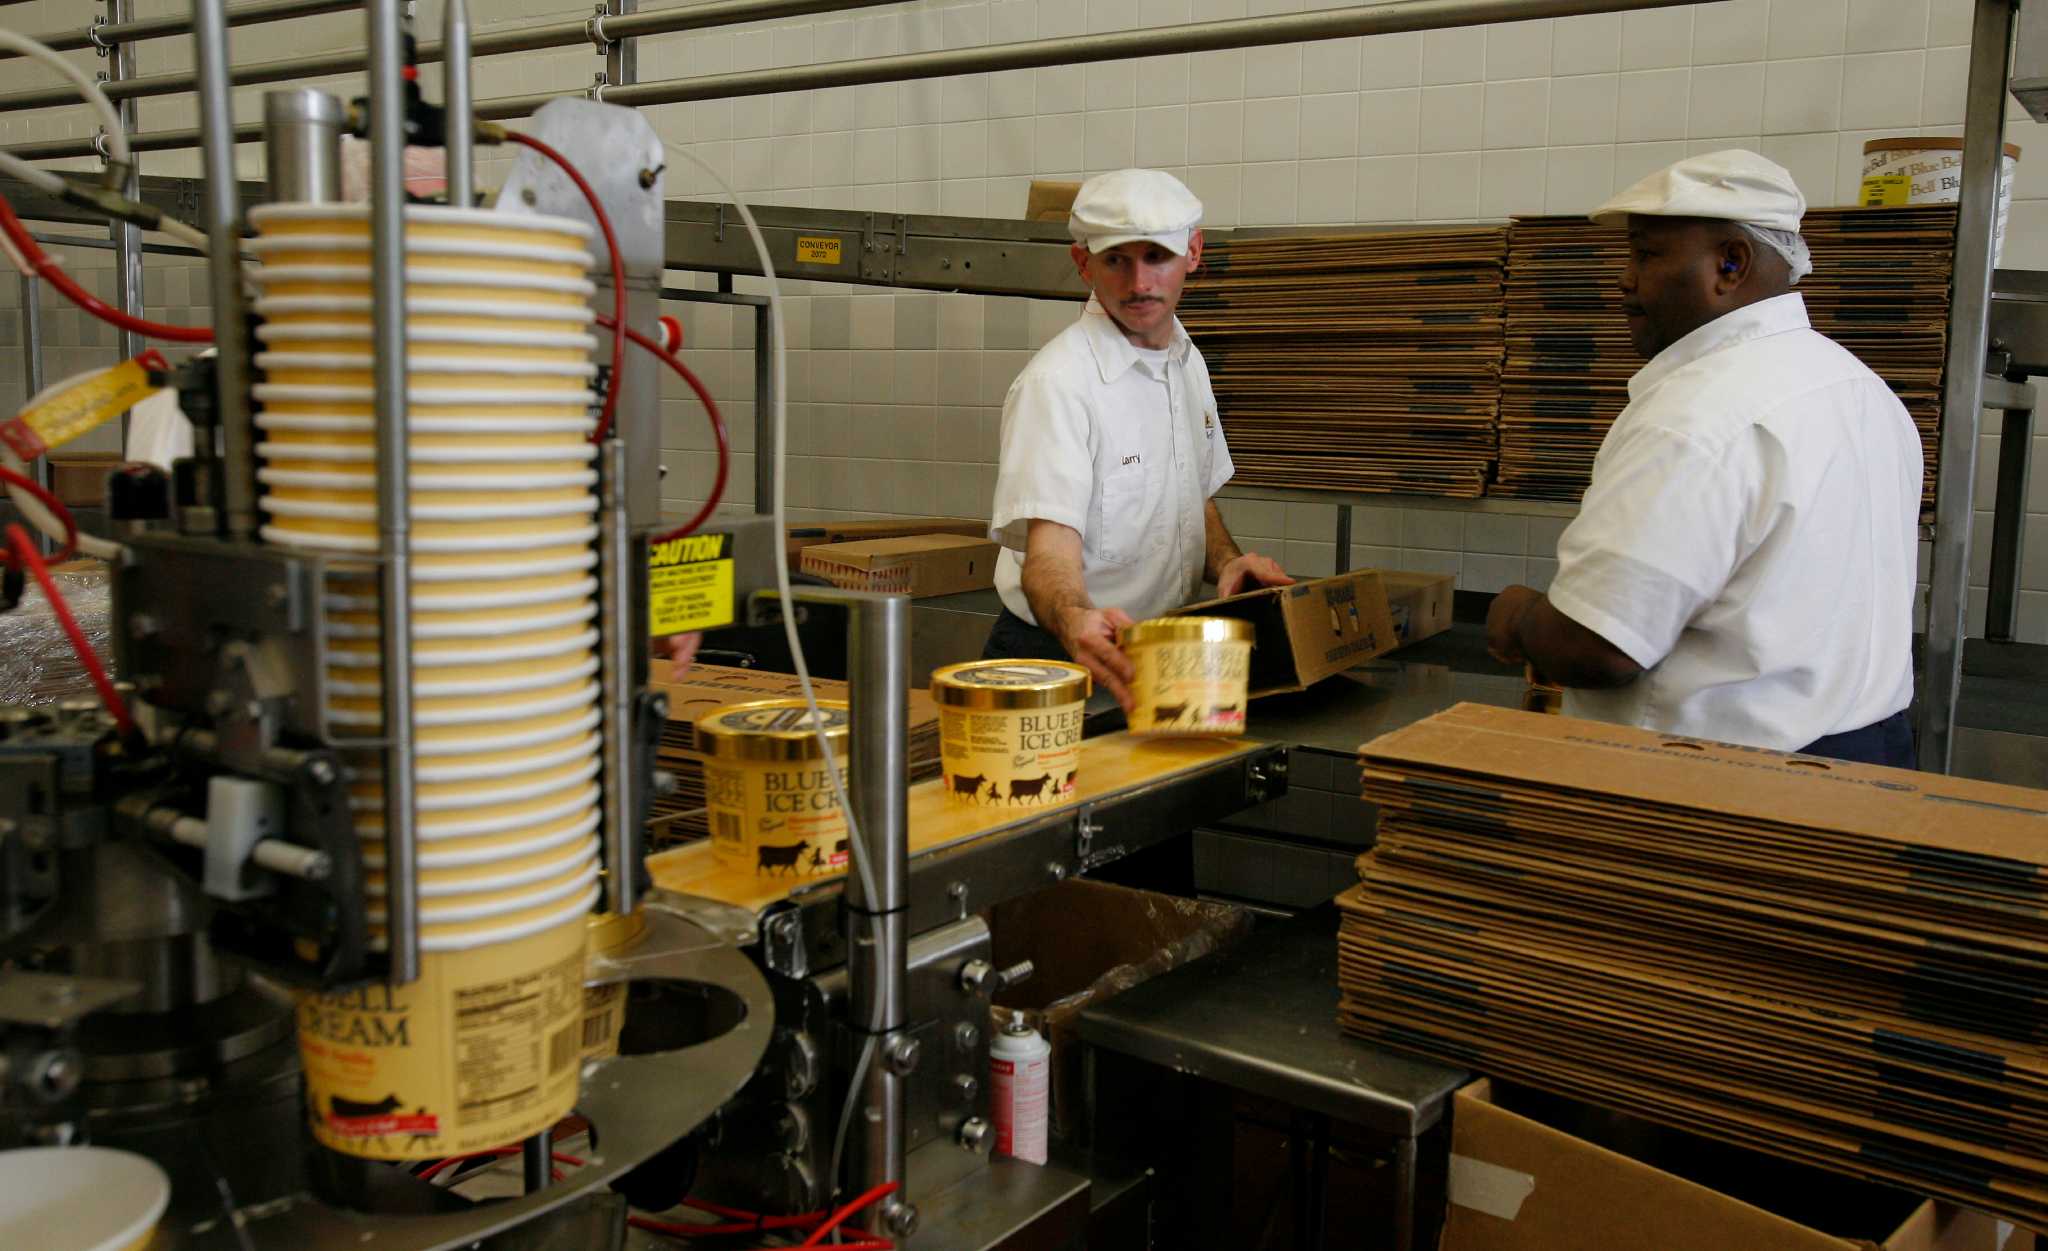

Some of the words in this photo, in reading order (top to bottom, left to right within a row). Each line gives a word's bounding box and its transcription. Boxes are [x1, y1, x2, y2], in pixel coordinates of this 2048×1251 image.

[799, 240, 839, 250] CONVEYOR
[649, 533, 724, 567] CAUTION
[1019, 712, 1070, 733] BLUE
[1019, 733, 1051, 751] ICE
[1638, 745, 1721, 763] RETURN
[763, 770, 832, 792] BLUE
[765, 793, 806, 813] ICE
